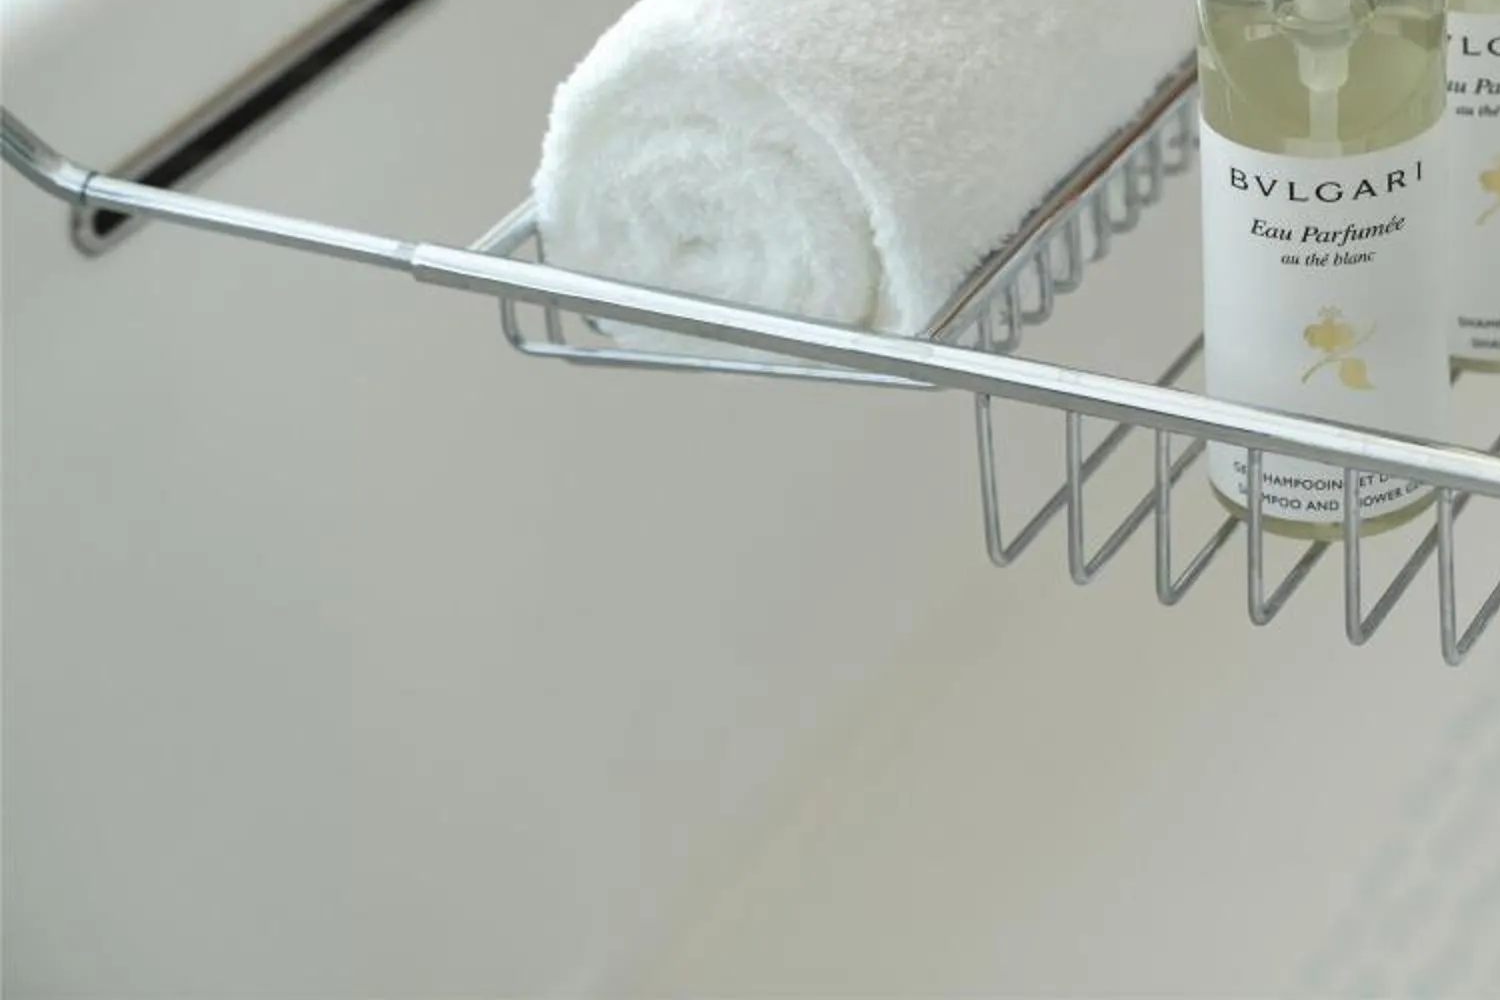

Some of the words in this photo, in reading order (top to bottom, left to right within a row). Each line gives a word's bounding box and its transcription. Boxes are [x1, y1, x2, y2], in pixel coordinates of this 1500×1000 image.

[1230, 160, 1422, 203] BVLGARI
[1251, 218, 1293, 242] Eau
[1301, 215, 1406, 247] Parfumée
[1281, 254, 1300, 266] au
[1305, 251, 1330, 268] thé
[1333, 251, 1377, 267] blanc
[1263, 472, 1343, 491] HAMPOOIN
[1306, 499, 1340, 512] AND
